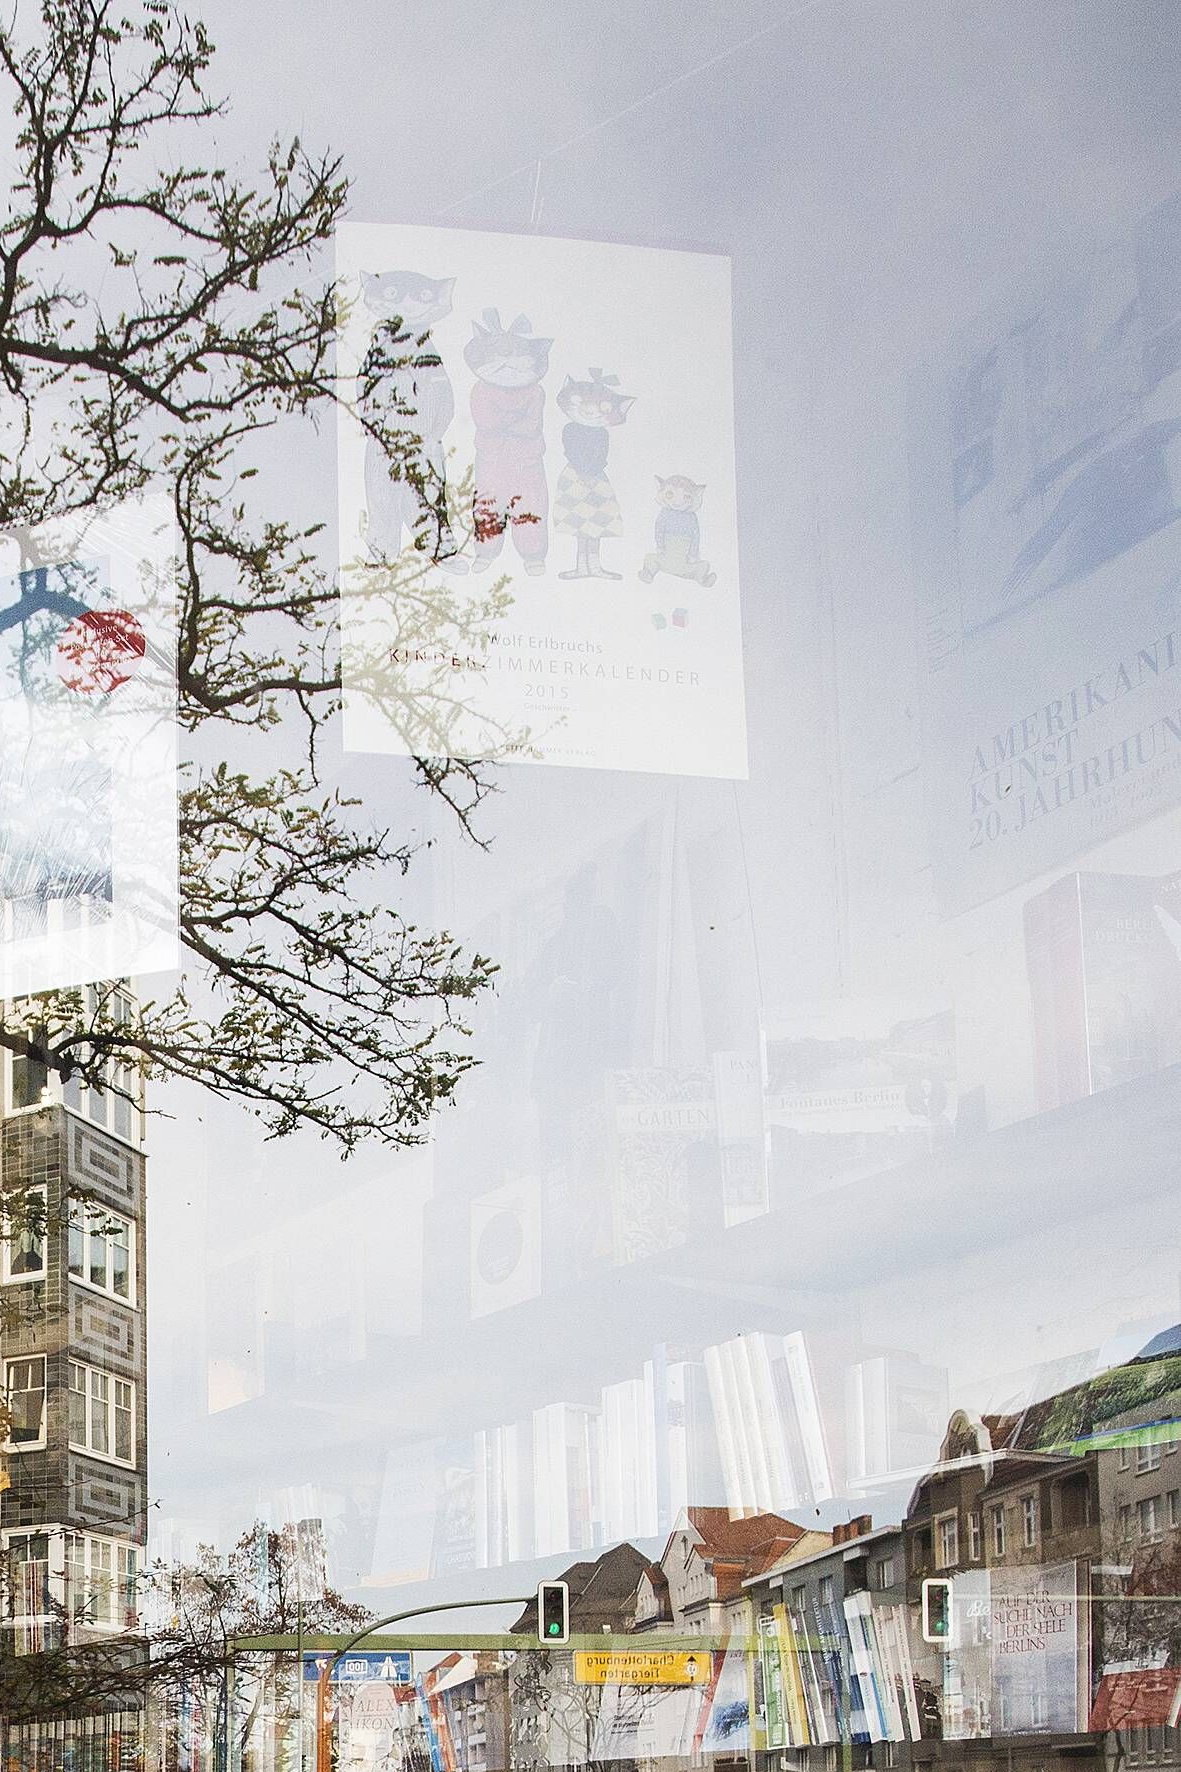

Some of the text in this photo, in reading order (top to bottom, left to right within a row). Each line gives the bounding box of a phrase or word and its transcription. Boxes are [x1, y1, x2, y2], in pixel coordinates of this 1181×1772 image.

[487, 633, 603, 655] Wolf Erlbruchs
[389, 649, 701, 685] KINDERZIMMERKALENDER
[524, 684, 569, 699] 2015
[969, 729, 1079, 815] KUNST
[852, 1087, 900, 1107] Berlin
[999, 1590, 1050, 1607] AUF DER
[994, 1602, 1072, 1625] SUCHE NACH
[1006, 1619, 1066, 1639] DER SEELE
[999, 1638, 1046, 1654] BERLINS
